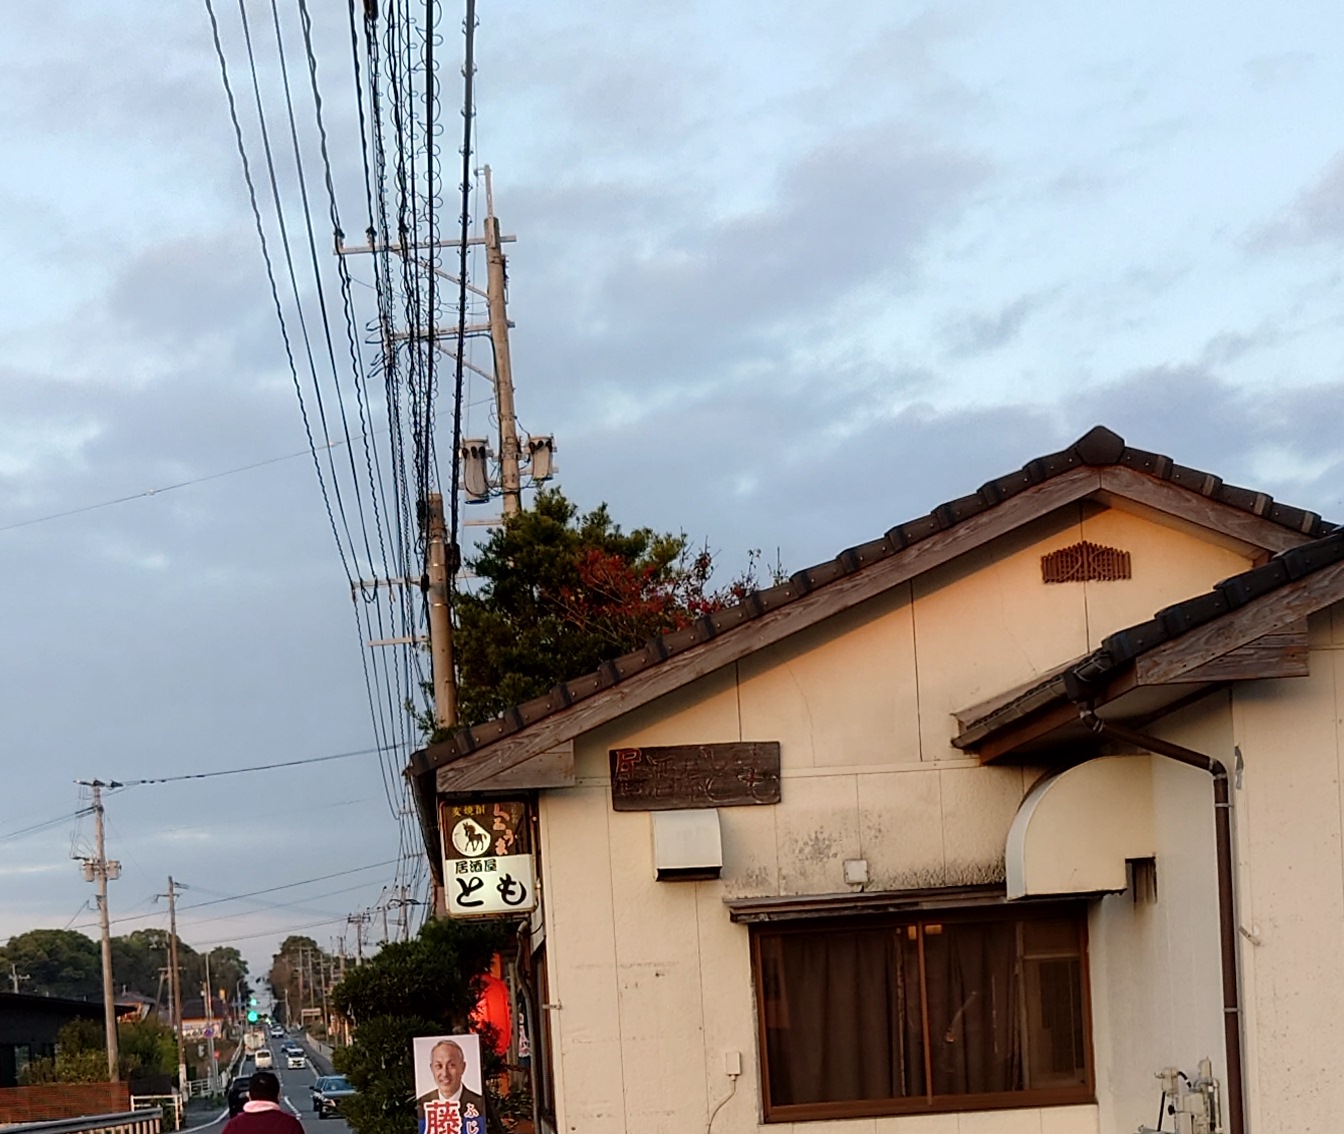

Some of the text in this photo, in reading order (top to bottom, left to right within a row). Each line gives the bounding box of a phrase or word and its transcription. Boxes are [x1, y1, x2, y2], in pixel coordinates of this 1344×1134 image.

[455, 859, 497, 875] 居酒屋
[456, 873, 527, 907] とも
